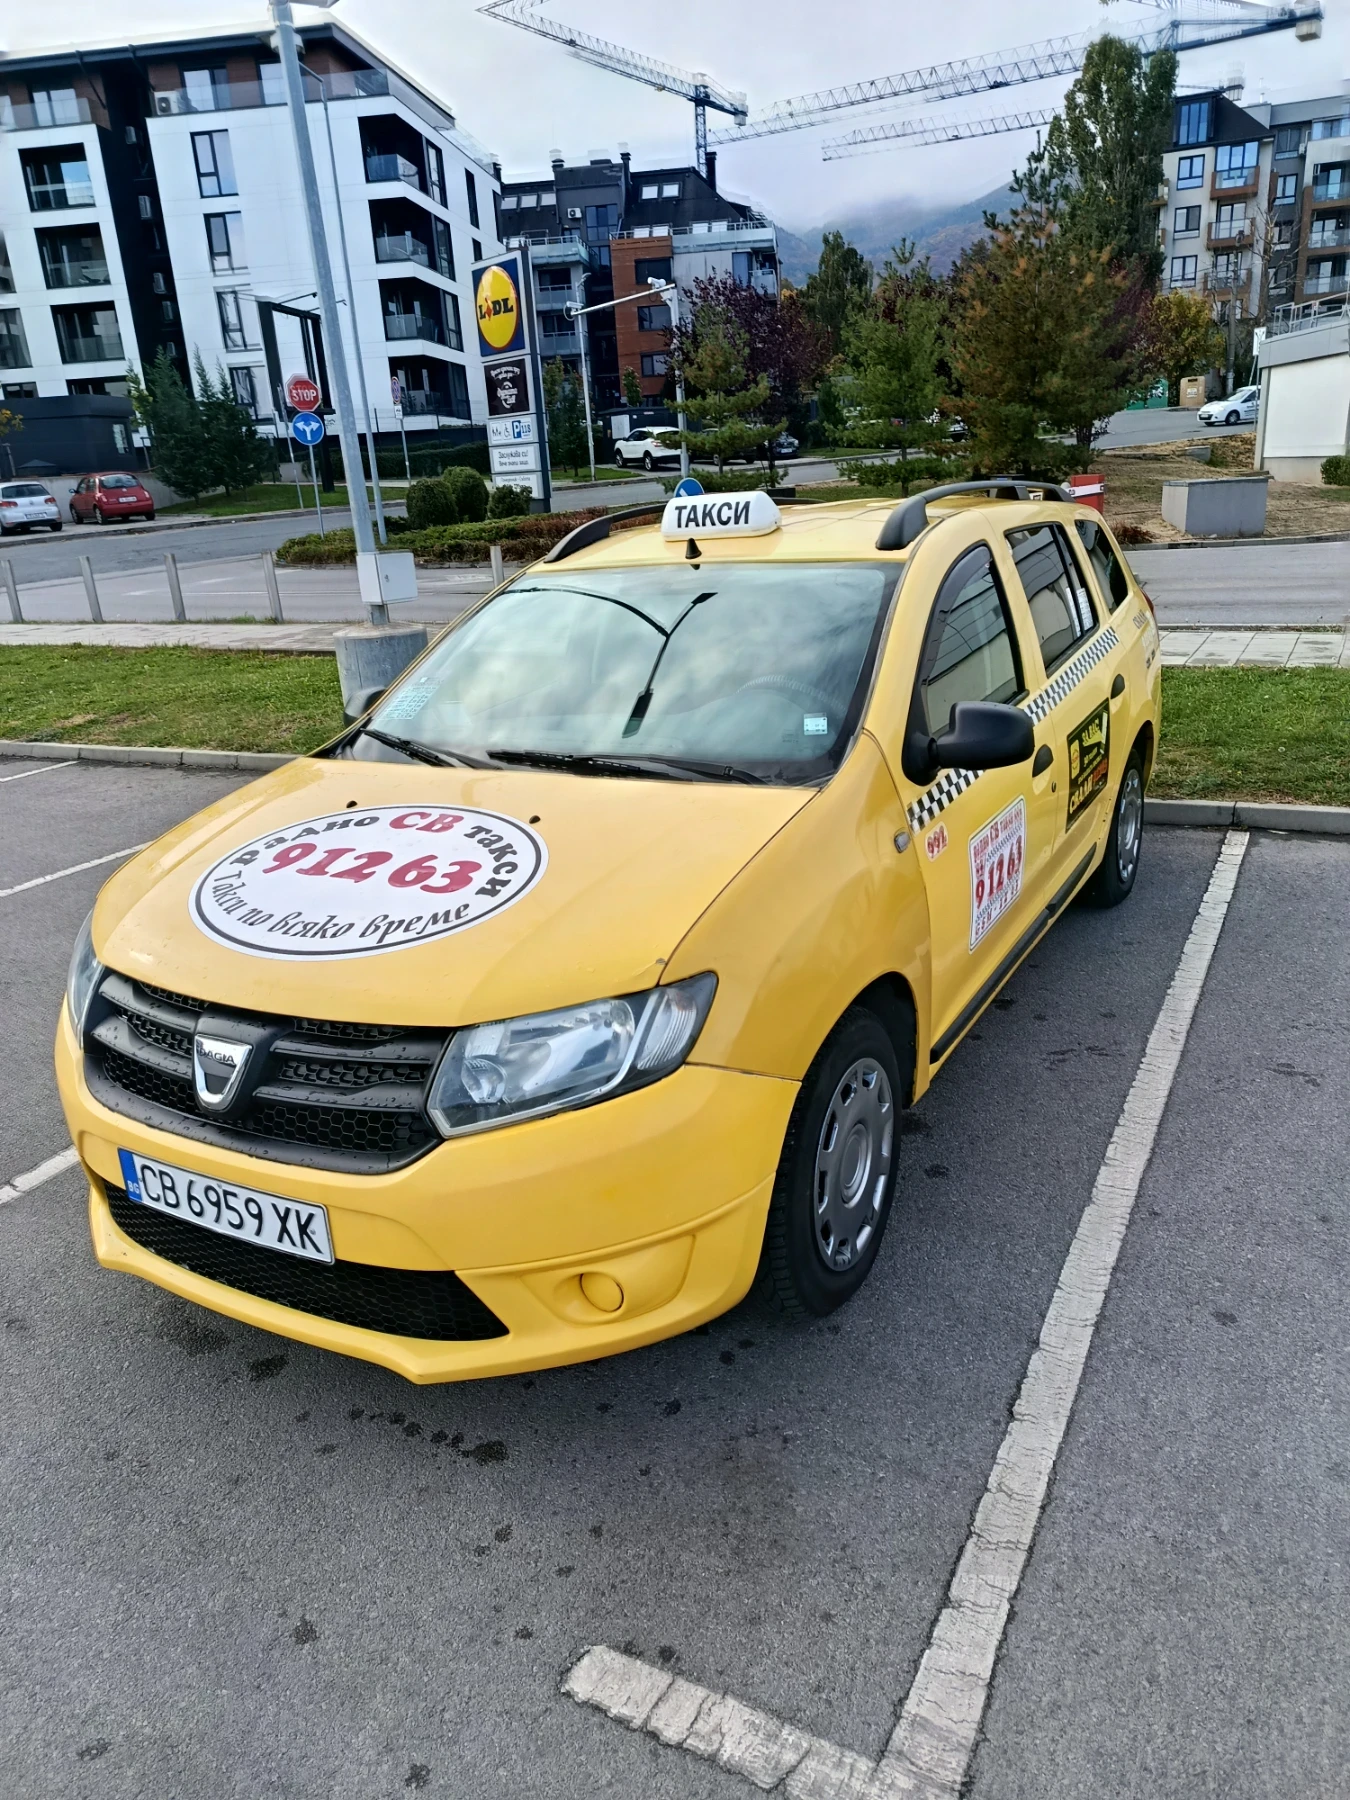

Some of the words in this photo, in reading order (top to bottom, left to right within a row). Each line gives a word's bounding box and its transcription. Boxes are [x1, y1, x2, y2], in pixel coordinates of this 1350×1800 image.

[479, 296, 514, 320] LIDL
[291, 388, 317, 402] STOP
[675, 501, 751, 528] ТАКСИ
[389, 811, 465, 833] СВ
[212, 870, 247, 915] Такси
[236, 908, 274, 926] по
[267, 911, 355, 939] всяко
[358, 903, 470, 944] време
[127, 1179, 140, 1194] BG
[187, 1178, 263, 1237] 6959
